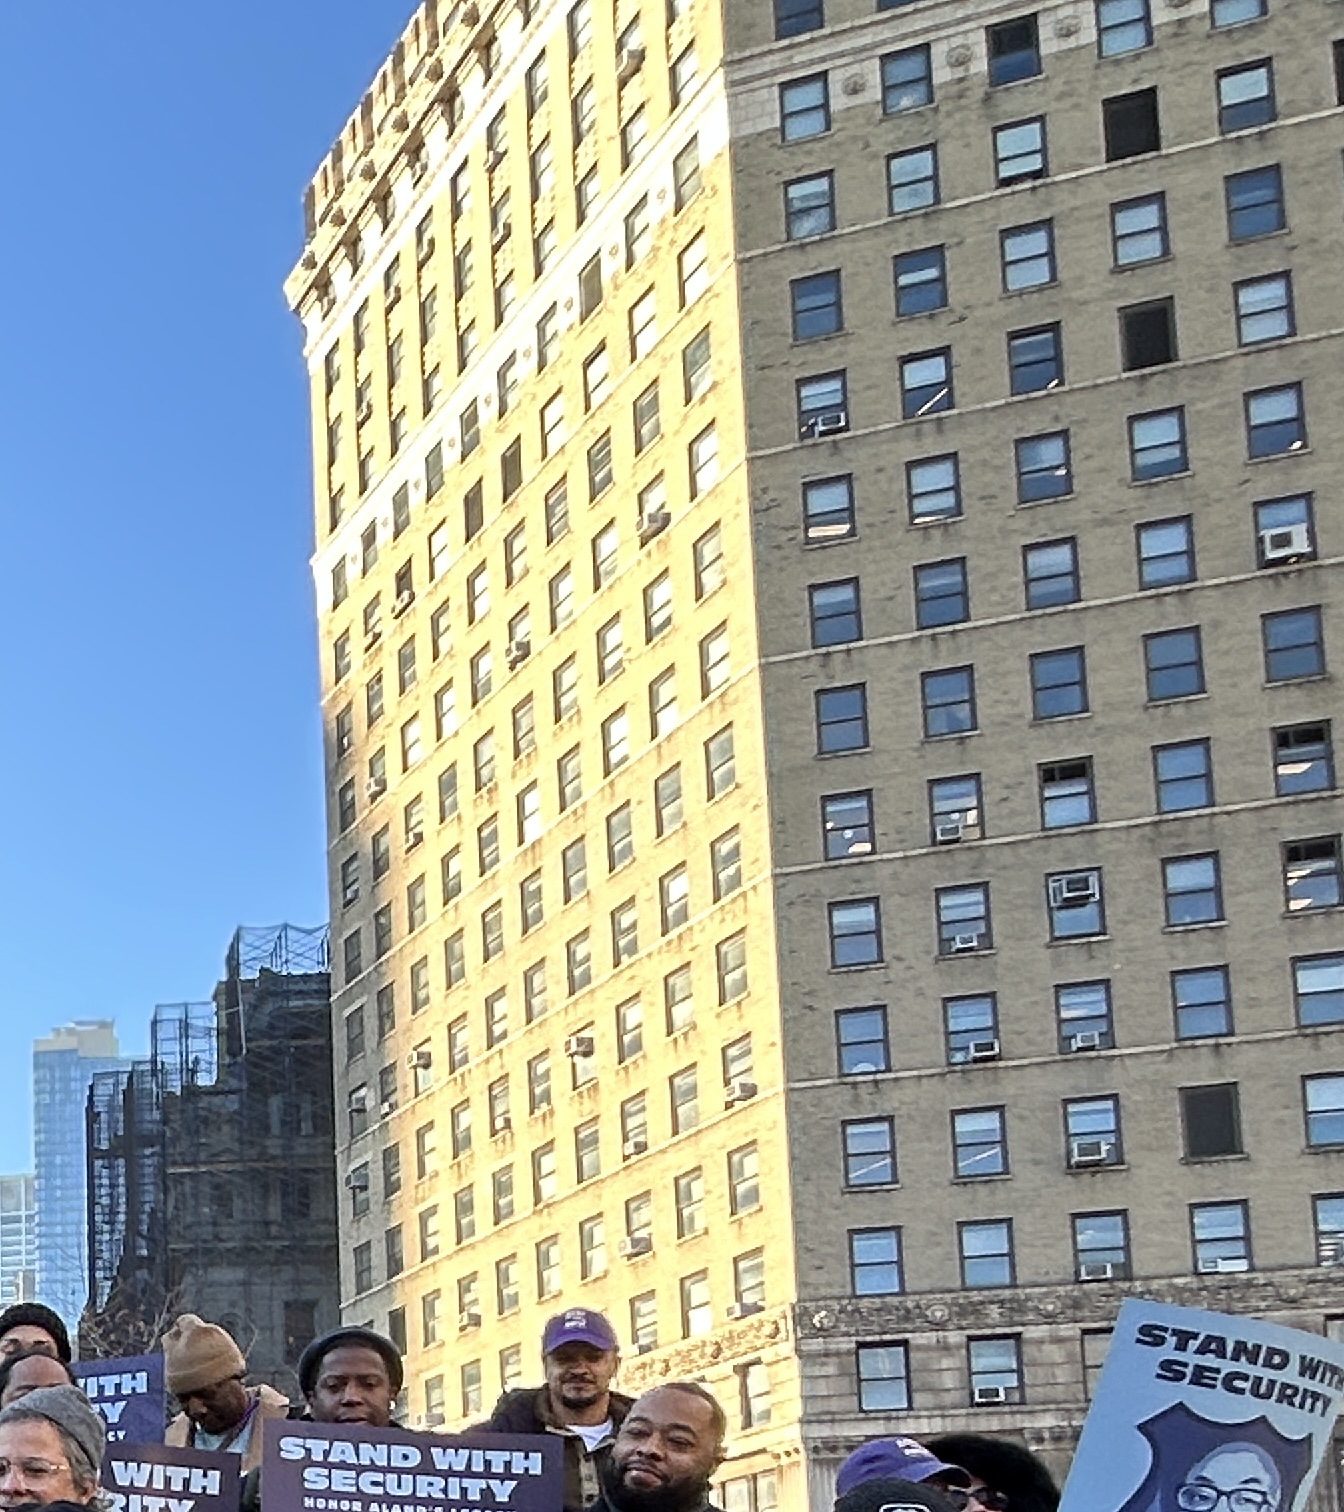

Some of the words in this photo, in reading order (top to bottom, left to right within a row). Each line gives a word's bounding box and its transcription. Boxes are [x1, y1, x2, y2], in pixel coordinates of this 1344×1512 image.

[1135, 1322, 1290, 1372] STAND
[1155, 1358, 1332, 1418] SECURITY
[279, 1436, 422, 1468] STAND
[430, 1446, 543, 1476] WITH
[111, 1460, 222, 1496] WITH
[302, 1466, 518, 1502] SECURITY
[303, 1496, 362, 1512] HONOR
